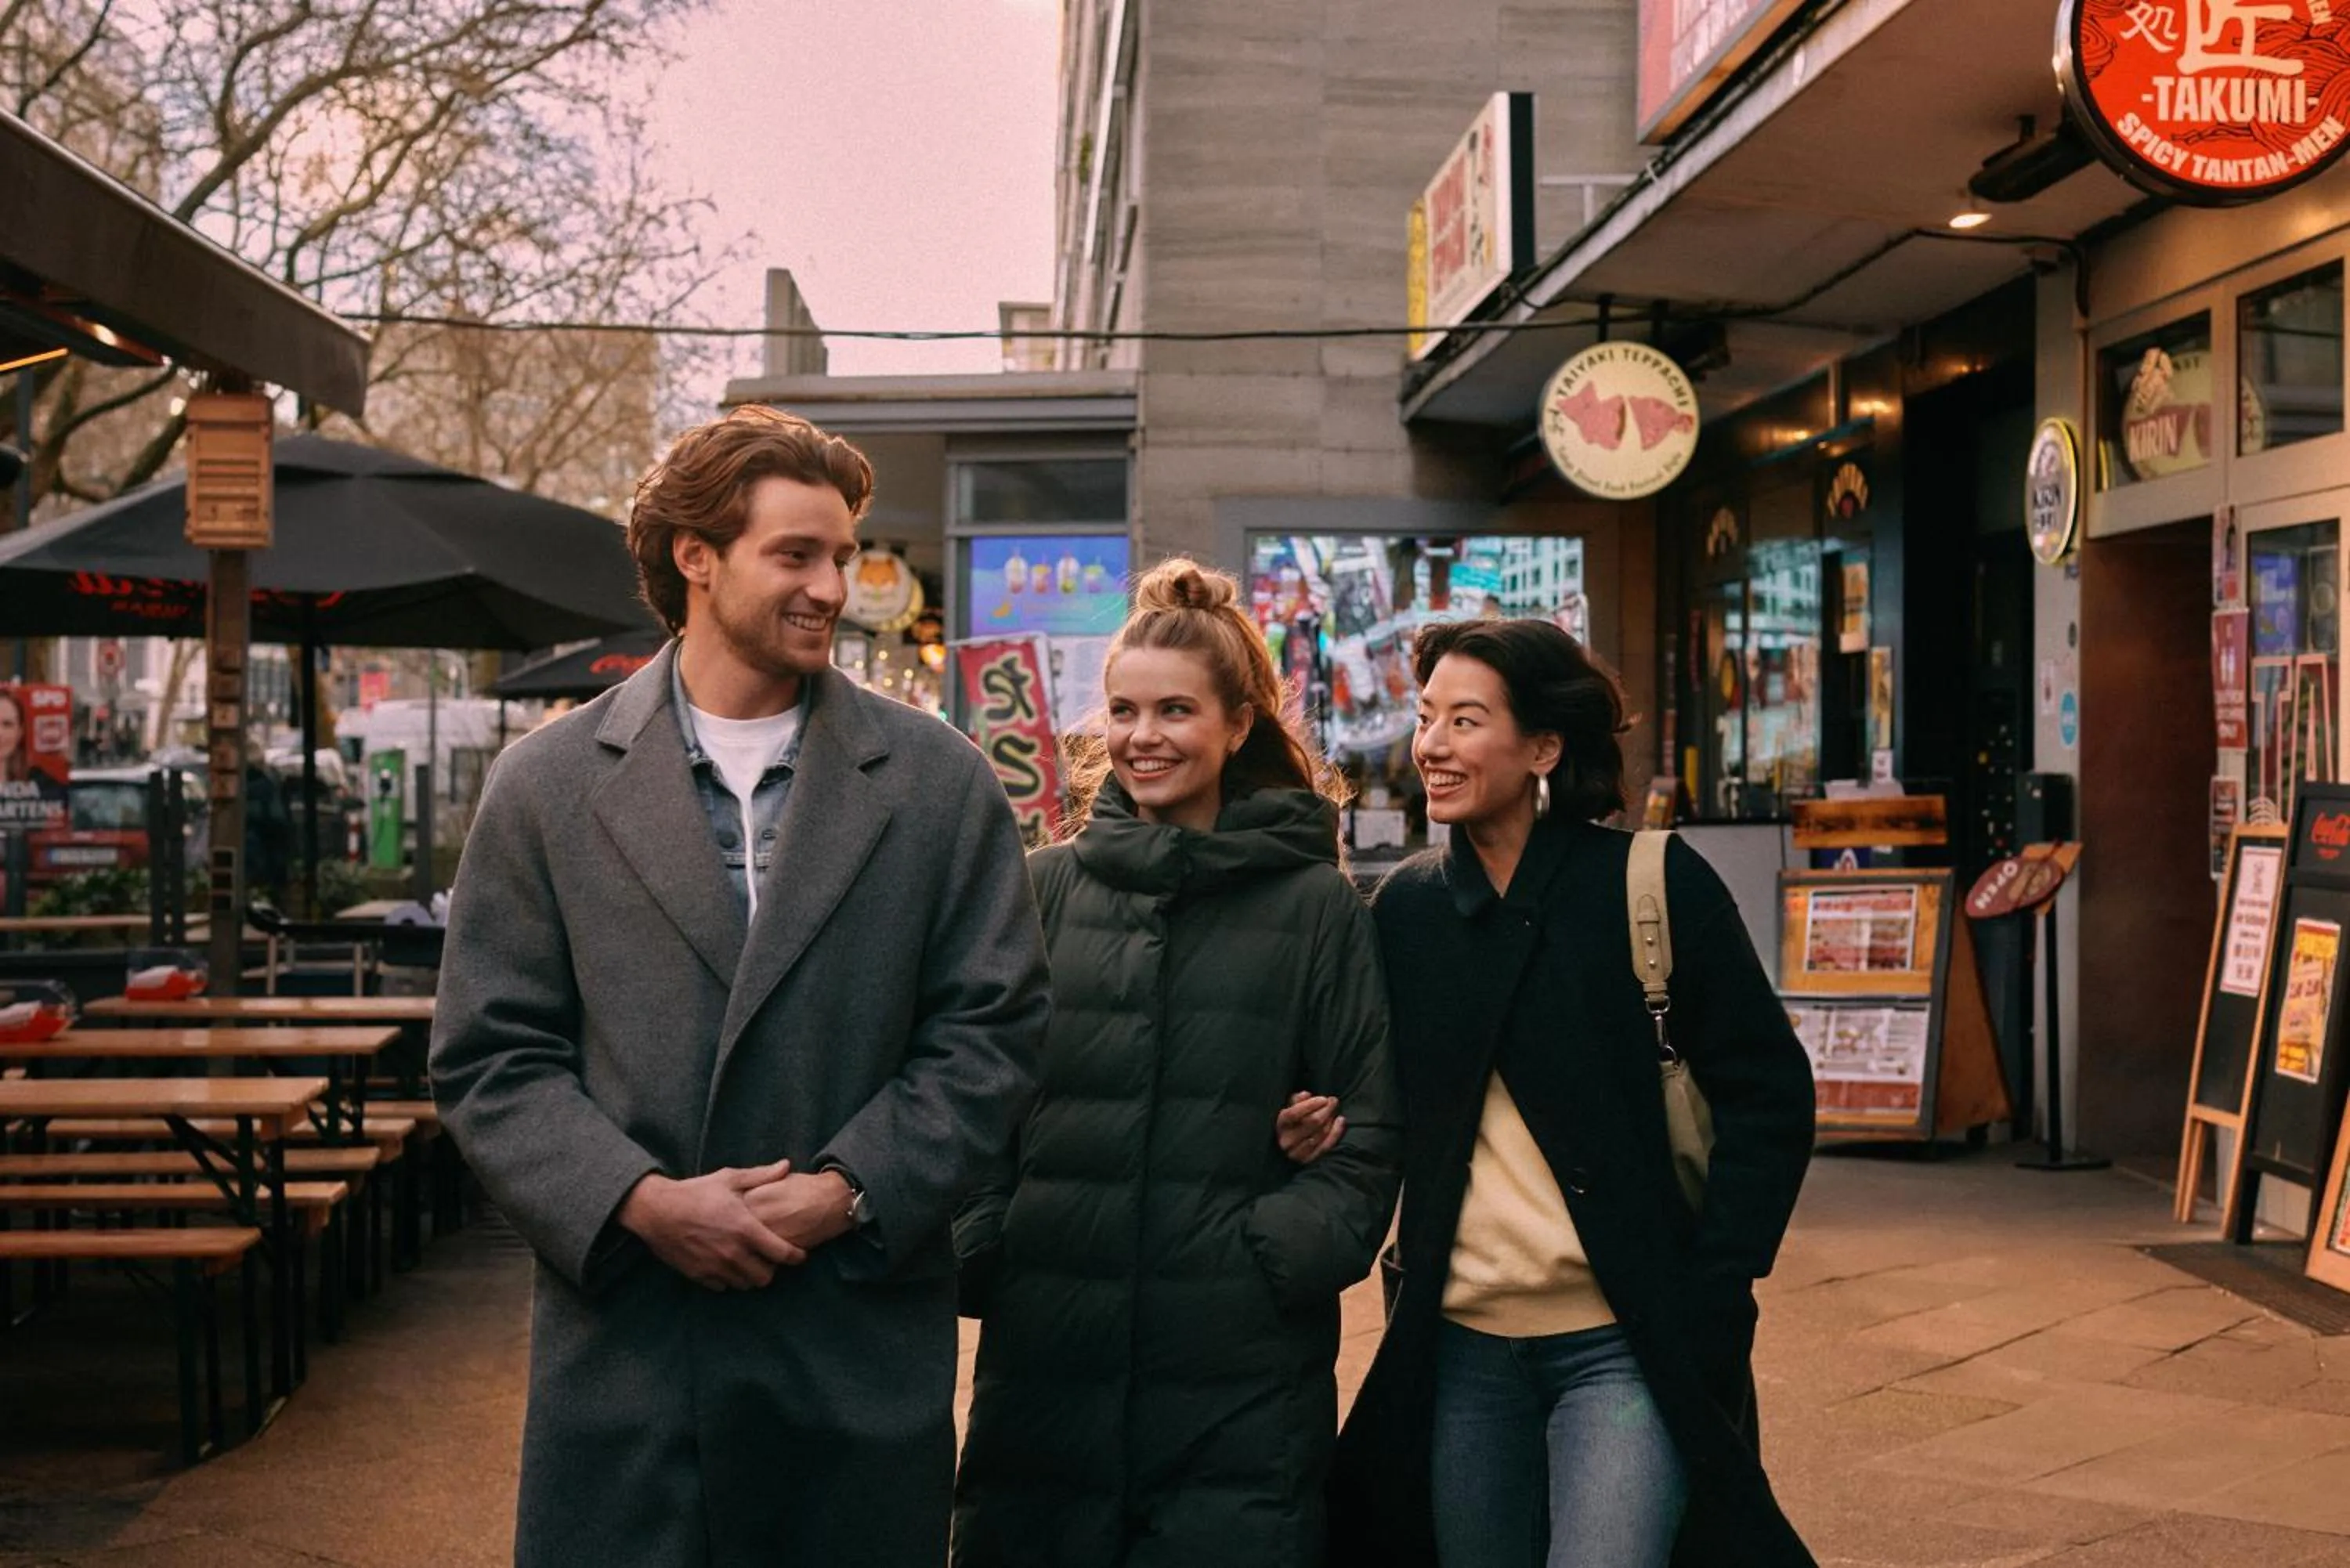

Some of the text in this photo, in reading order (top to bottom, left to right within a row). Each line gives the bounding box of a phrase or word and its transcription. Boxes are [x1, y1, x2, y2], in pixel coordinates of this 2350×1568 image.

[2305, 0, 2333, 24] EN
[2117, 112, 2346, 183] SPICY TANTAN-MEN
[1556, 349, 1614, 397] TAIYAKI
[2128, 413, 2178, 464] KIRIN
[31, 690, 66, 707] SPD
[1975, 860, 2019, 910] OPEN
